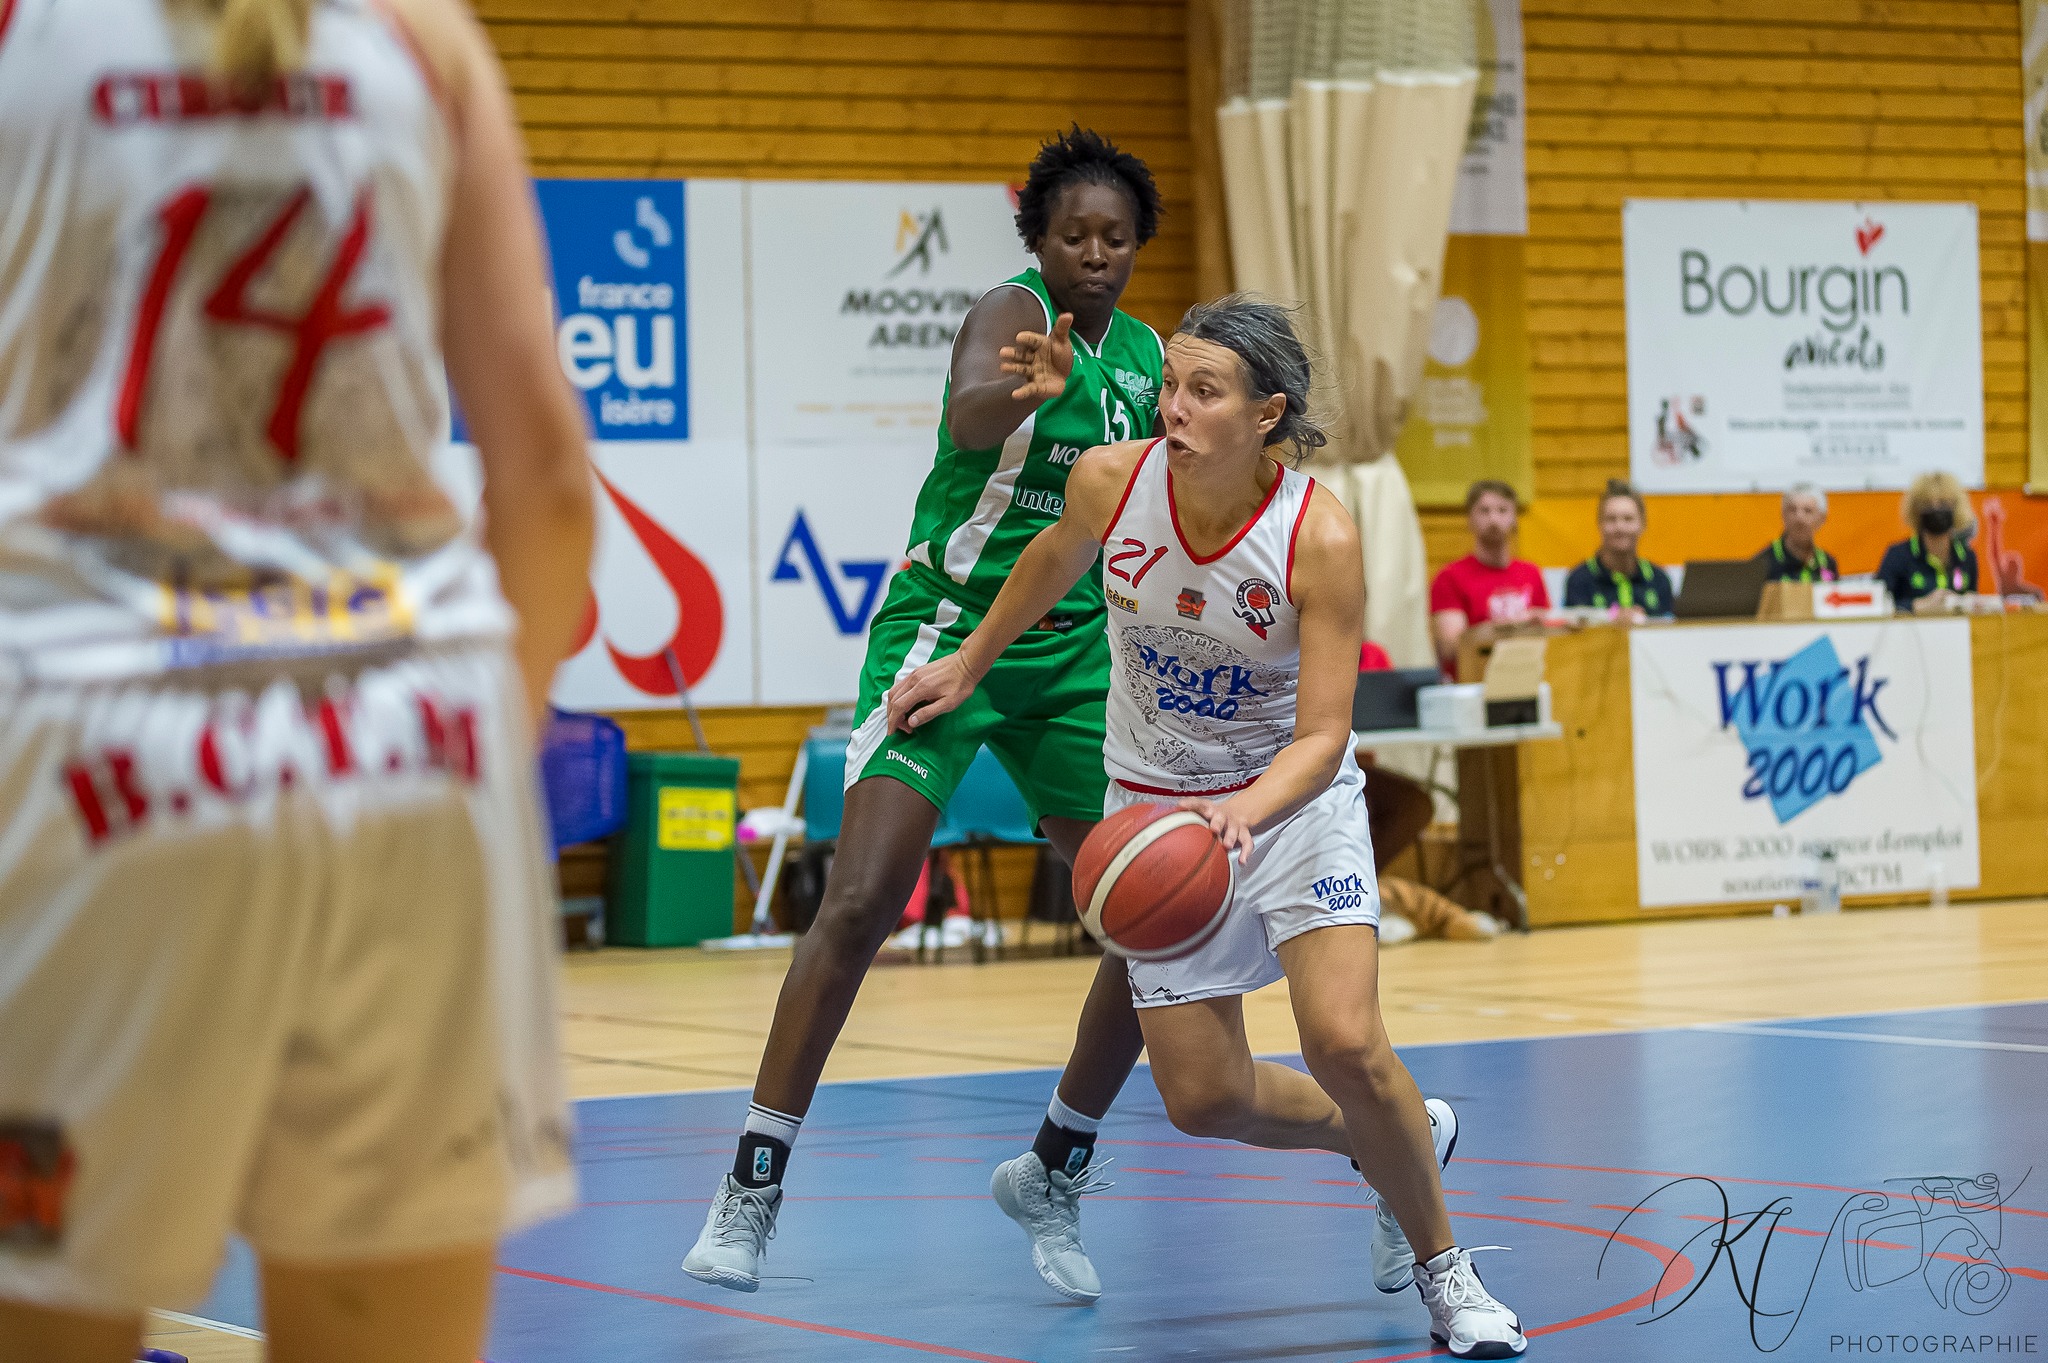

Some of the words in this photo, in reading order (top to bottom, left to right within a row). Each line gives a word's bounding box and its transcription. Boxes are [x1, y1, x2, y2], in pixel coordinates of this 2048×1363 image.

[579, 275, 674, 309] france
[1680, 249, 1909, 332] Bourgin
[114, 183, 392, 462] 14
[1101, 388, 1131, 445] 15
[1108, 538, 1169, 589] 21
[1129, 637, 1270, 698] Work
[1156, 687, 1239, 721] 2000
[1710, 653, 1899, 740] Work
[886, 750, 928, 779] SPALDING
[1743, 744, 1858, 798] 2000
[1733, 834, 1795, 861] 2000
[1311, 873, 1369, 899] Work
[1328, 893, 1362, 911] 2000
